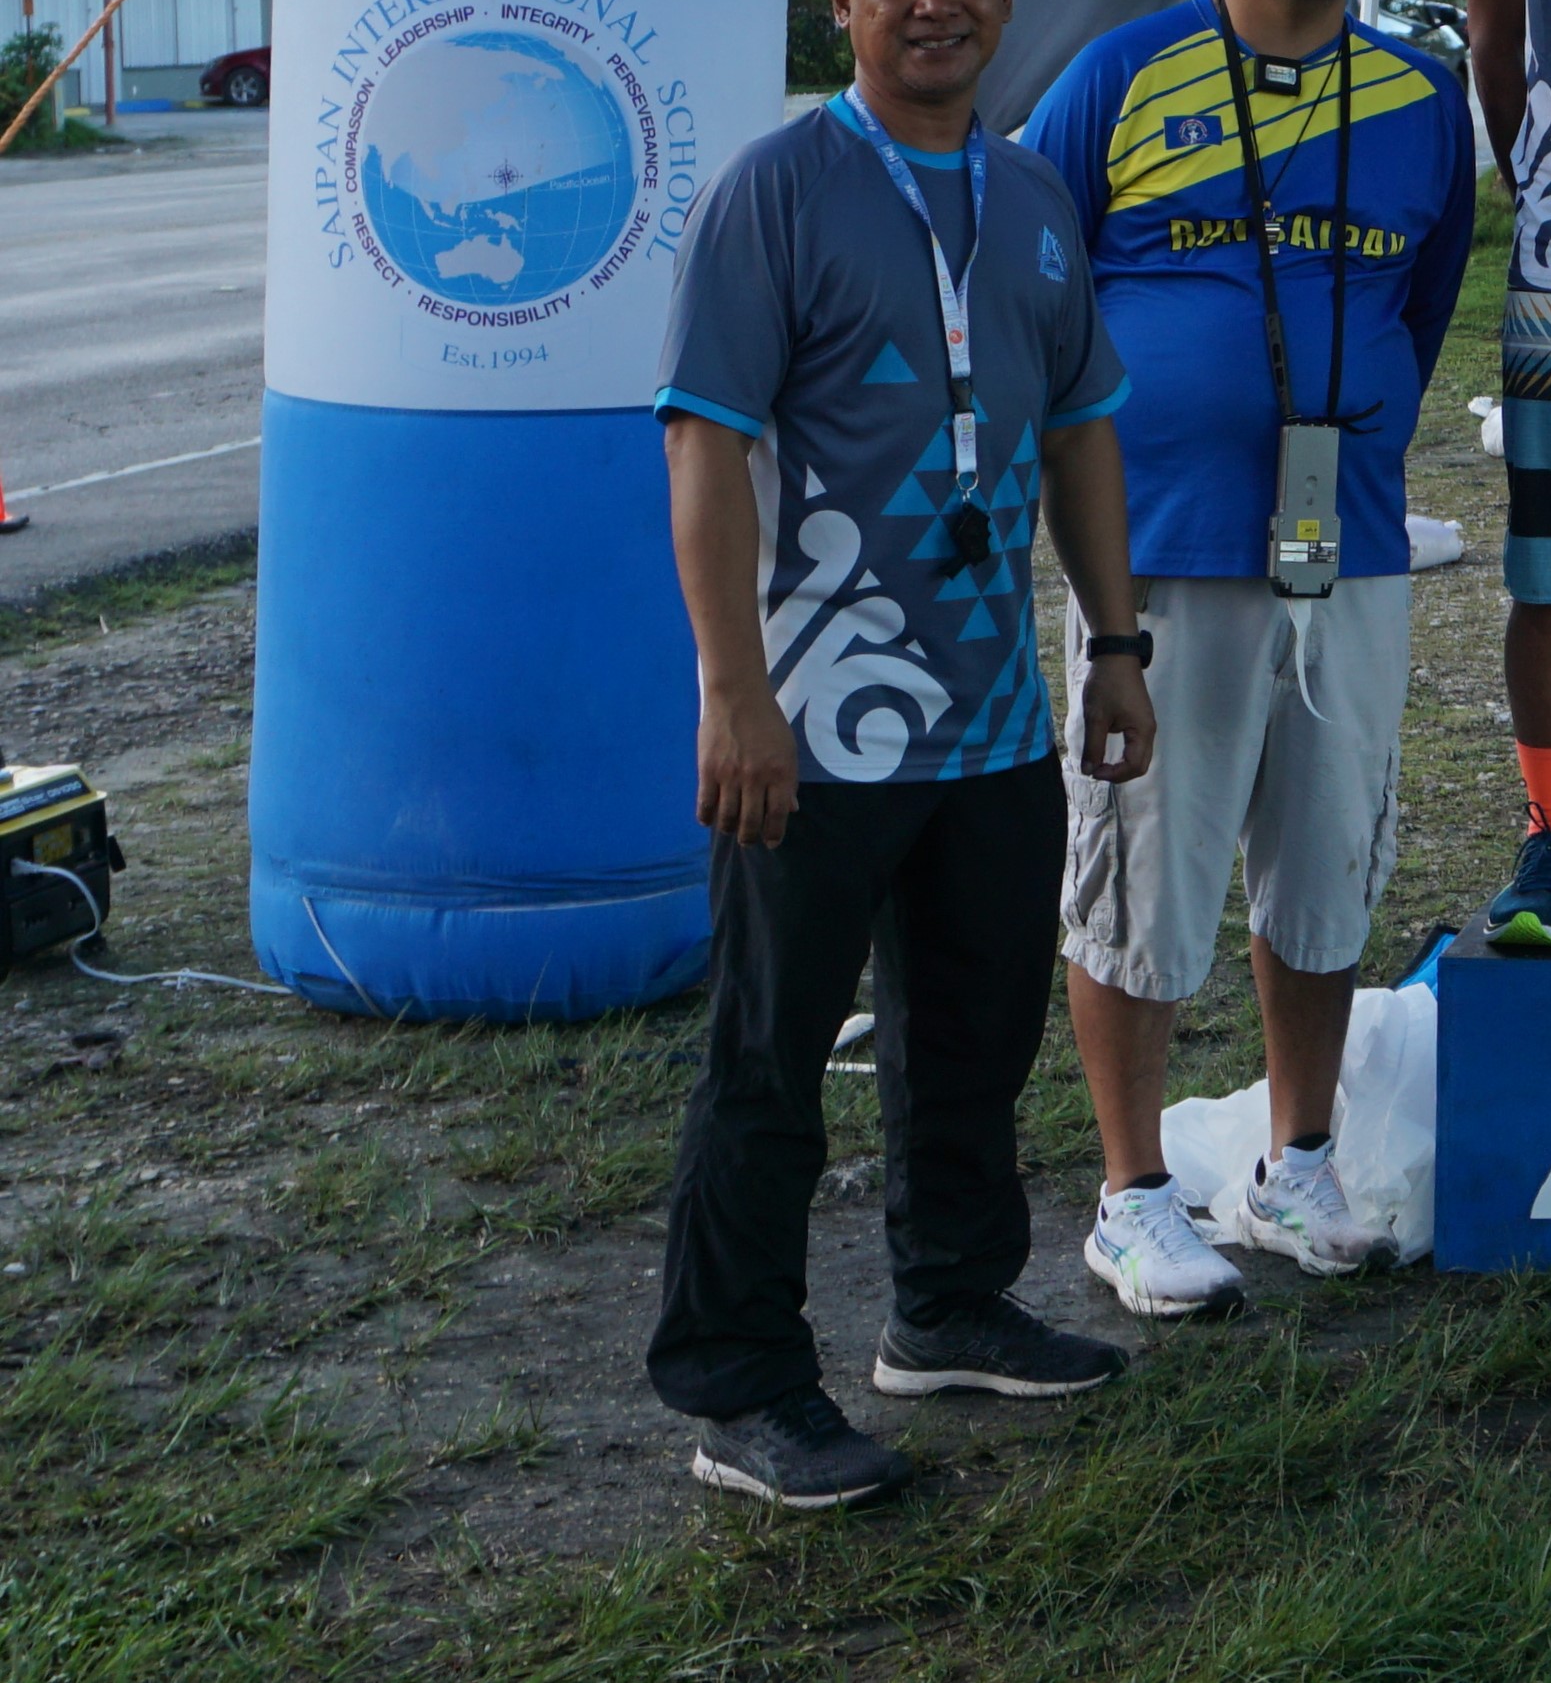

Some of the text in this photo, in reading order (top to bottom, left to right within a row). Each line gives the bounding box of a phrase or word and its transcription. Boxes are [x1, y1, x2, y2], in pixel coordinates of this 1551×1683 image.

[315, 98, 355, 270] SAIPAN
[646, 79, 698, 262] SCHOOL
[344, 2, 658, 194] COMPASSION LEADERSHIP INTEGRITY PERSEVERANCE
[548, 177, 578, 191] Pacific
[350, 209, 651, 328] RESPECT RESPONSIBILITY INITIATIVE
